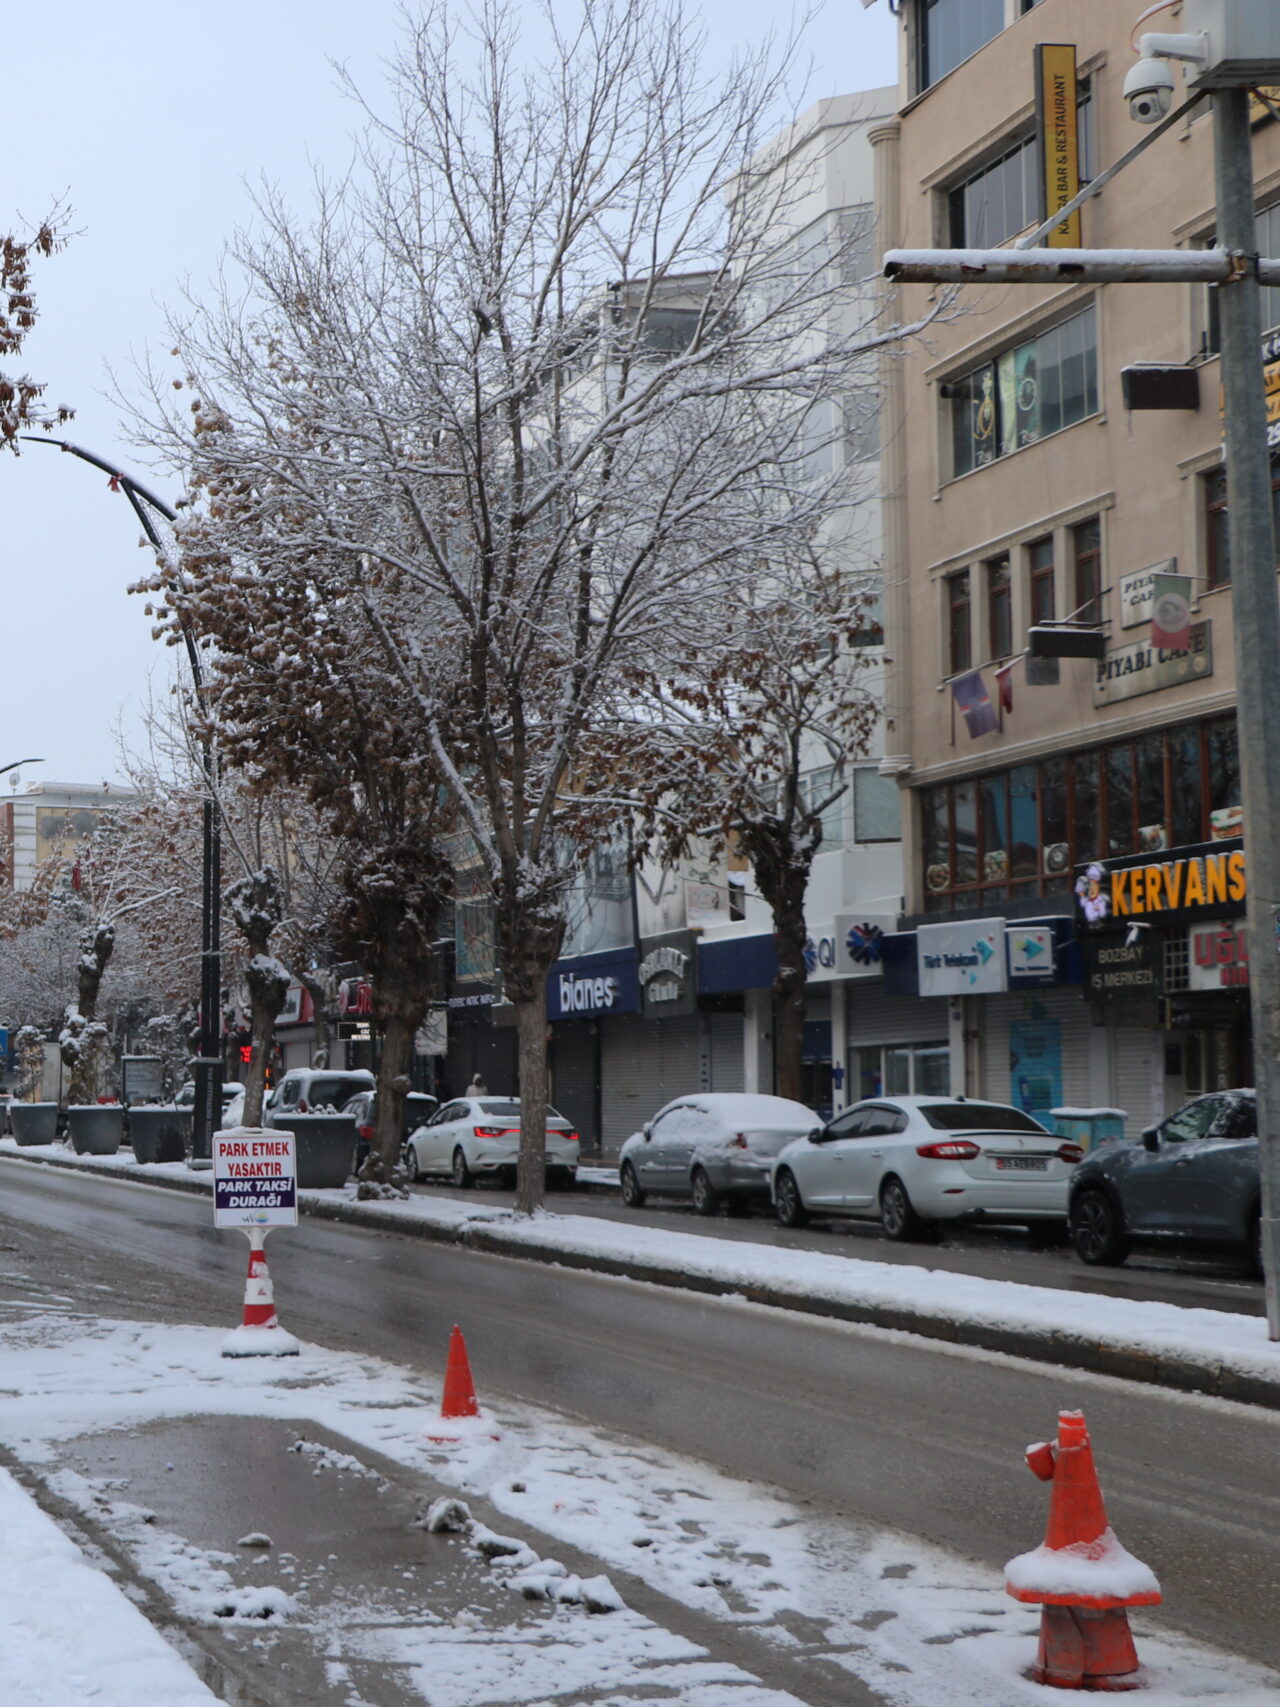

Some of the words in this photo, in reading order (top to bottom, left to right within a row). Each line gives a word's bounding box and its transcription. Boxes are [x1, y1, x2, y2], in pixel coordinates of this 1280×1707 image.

[1053, 74, 1067, 153] RESTAURANT
[1056, 154, 1068, 165] &
[1056, 167, 1068, 191] BAR
[1130, 590, 1154, 606] CAF
[1098, 946, 1143, 963] BOZBAY
[219, 1143, 249, 1157] PARK
[252, 1142, 289, 1156] ETMEK
[228, 1162, 282, 1177] YASAKTIR
[218, 1181, 253, 1192] PARK
[255, 1177, 293, 1191] TAKSİ
[229, 1193, 281, 1207] DURAĞI
